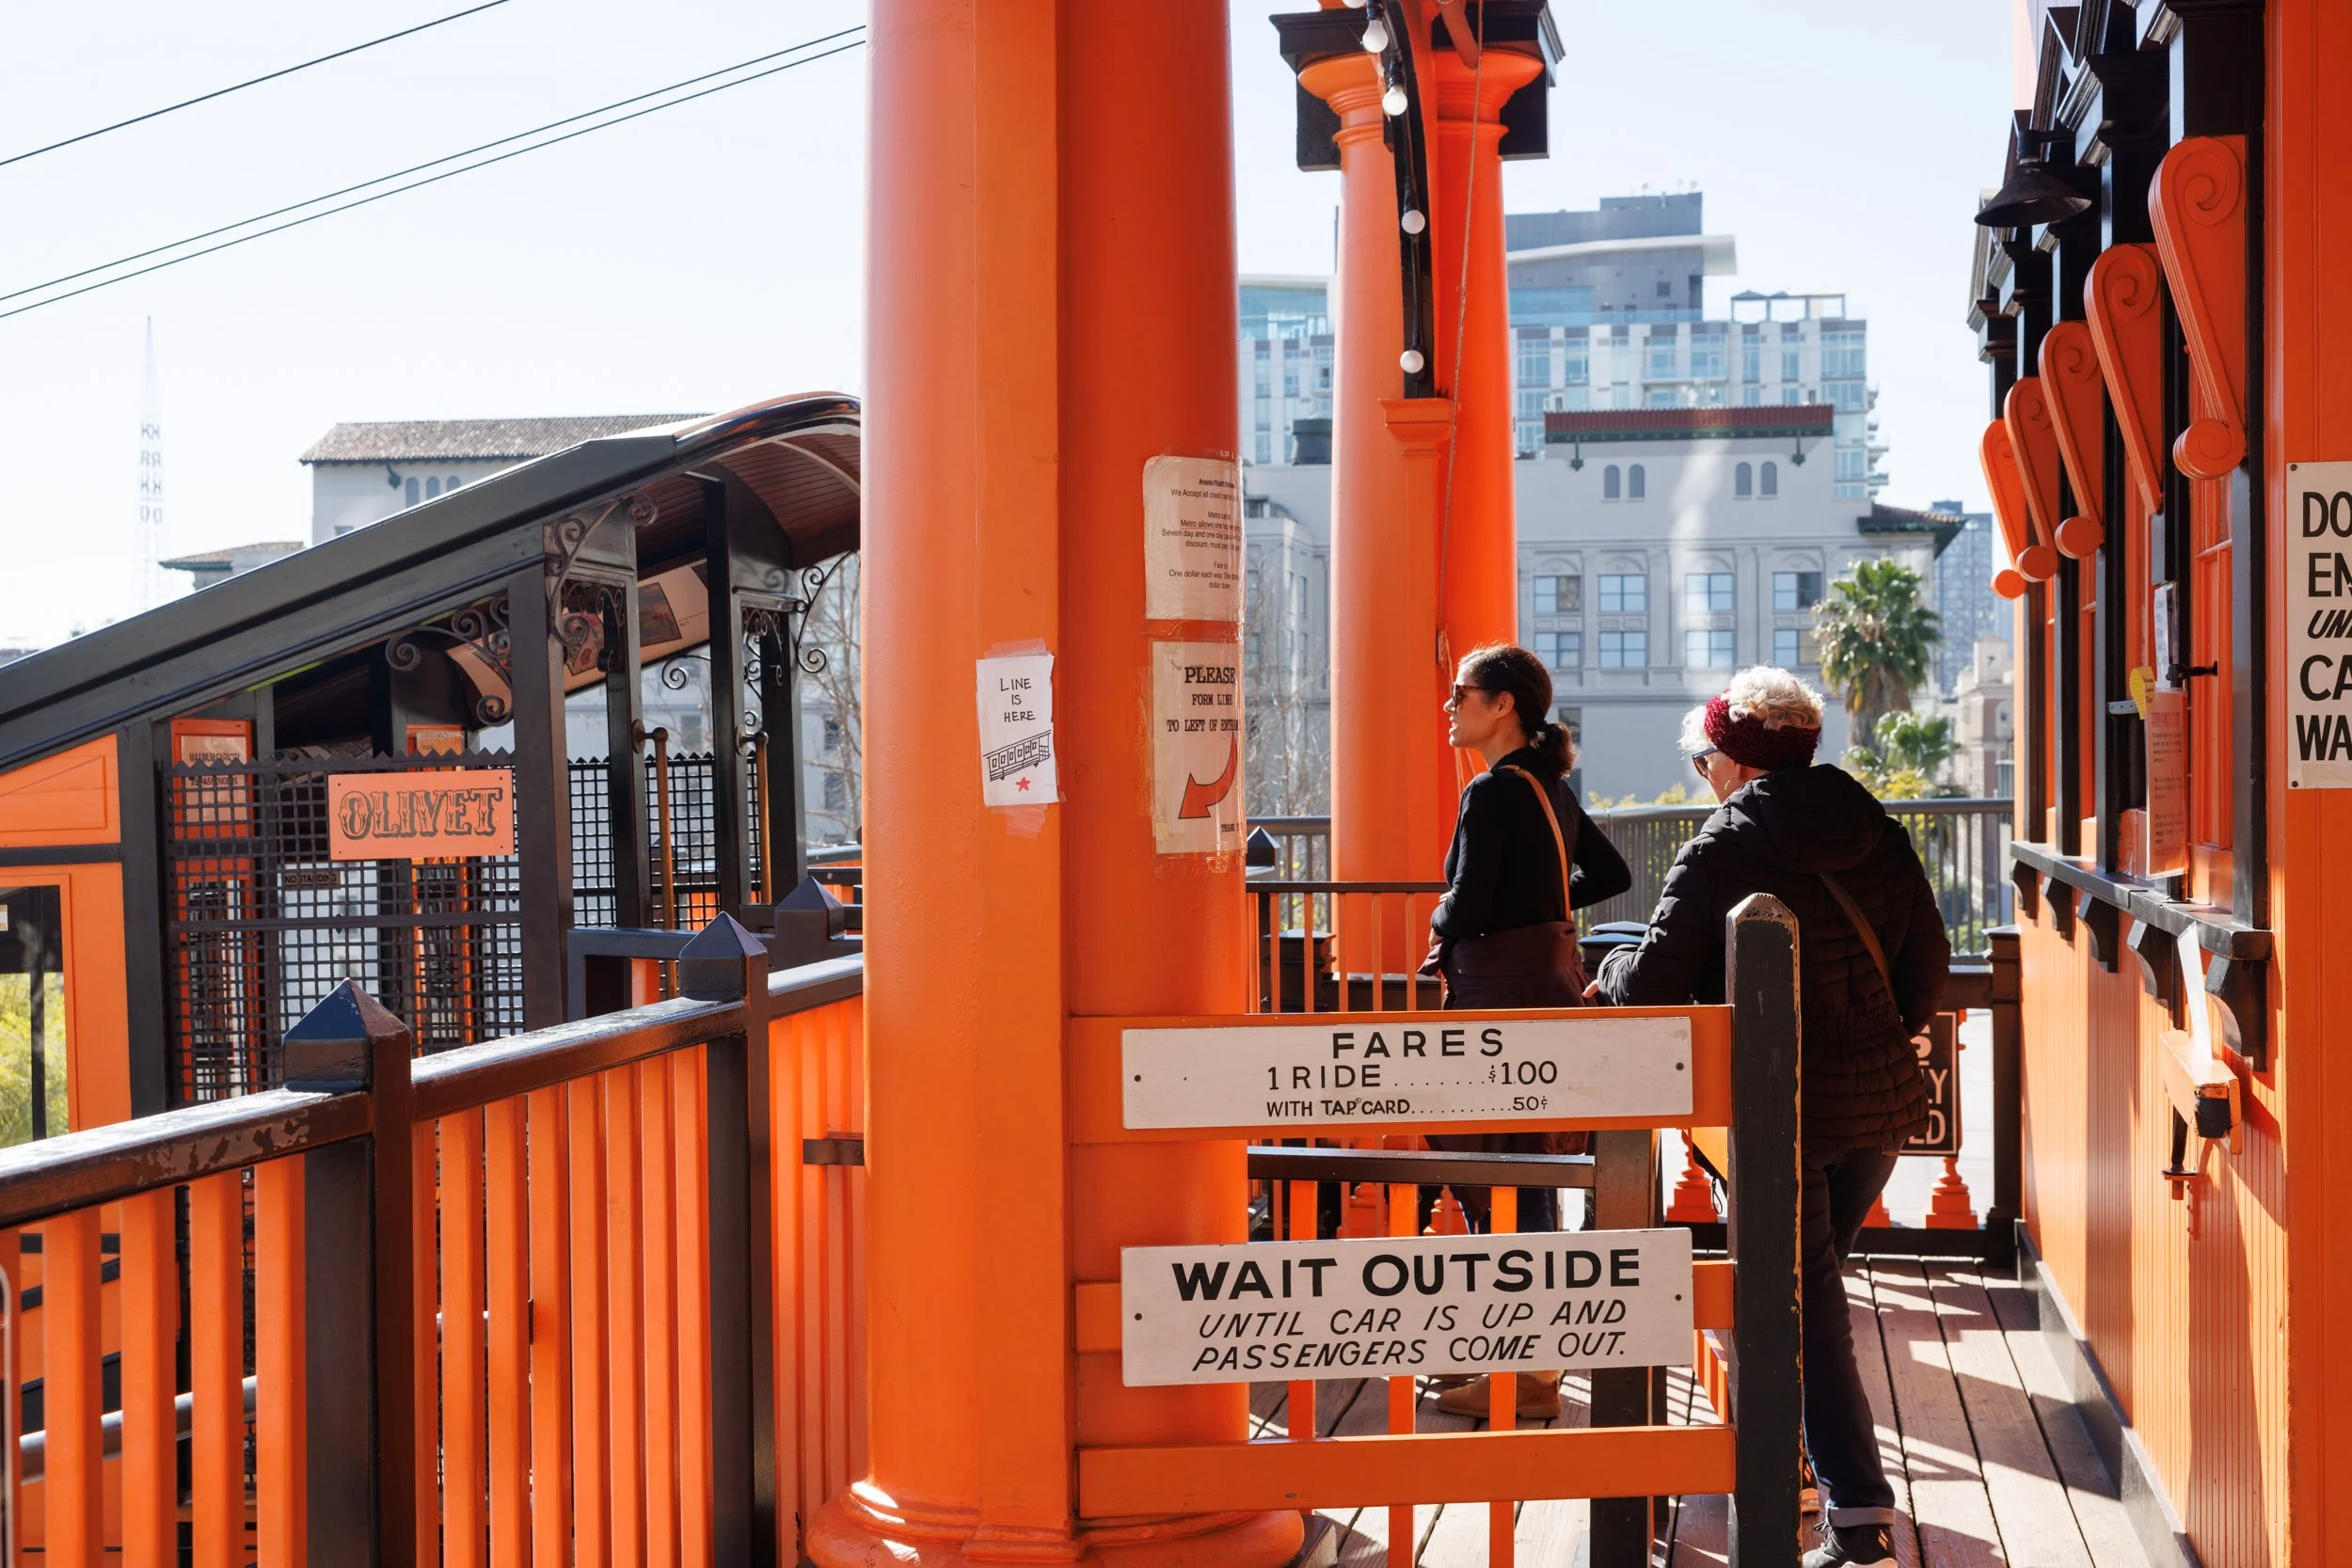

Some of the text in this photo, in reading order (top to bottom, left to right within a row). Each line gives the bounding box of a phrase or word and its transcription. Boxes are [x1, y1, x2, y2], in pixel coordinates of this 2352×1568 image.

[1183, 490, 1202, 499] Accept
[1198, 520, 1215, 529] allows
[1183, 531, 1194, 539] day
[1000, 677, 1032, 692] LINE
[1011, 694, 1022, 705] IS
[1192, 694, 1233, 705] FORM LINE
[1004, 710, 1036, 722] HERE
[1167, 720, 1180, 732] TO
[1184, 720, 1205, 732] LEFT
[1210, 720, 1218, 732] OF
[340, 788, 503, 840] OLIVET
[285, 875, 297, 883] NO
[1332, 1028, 1503, 1059] FARES
[1267, 1066, 1279, 1090] 1
[1293, 1064, 1381, 1089] RIDE
[1266, 1101, 1313, 1117] WITH
[1171, 1248, 1640, 1302] WAIT OUTSIDE
[1199, 1299, 1627, 1338] UNTIL CAR IS UP AND
[1192, 1331, 1627, 1371] PASSENGERS COME OUT.
